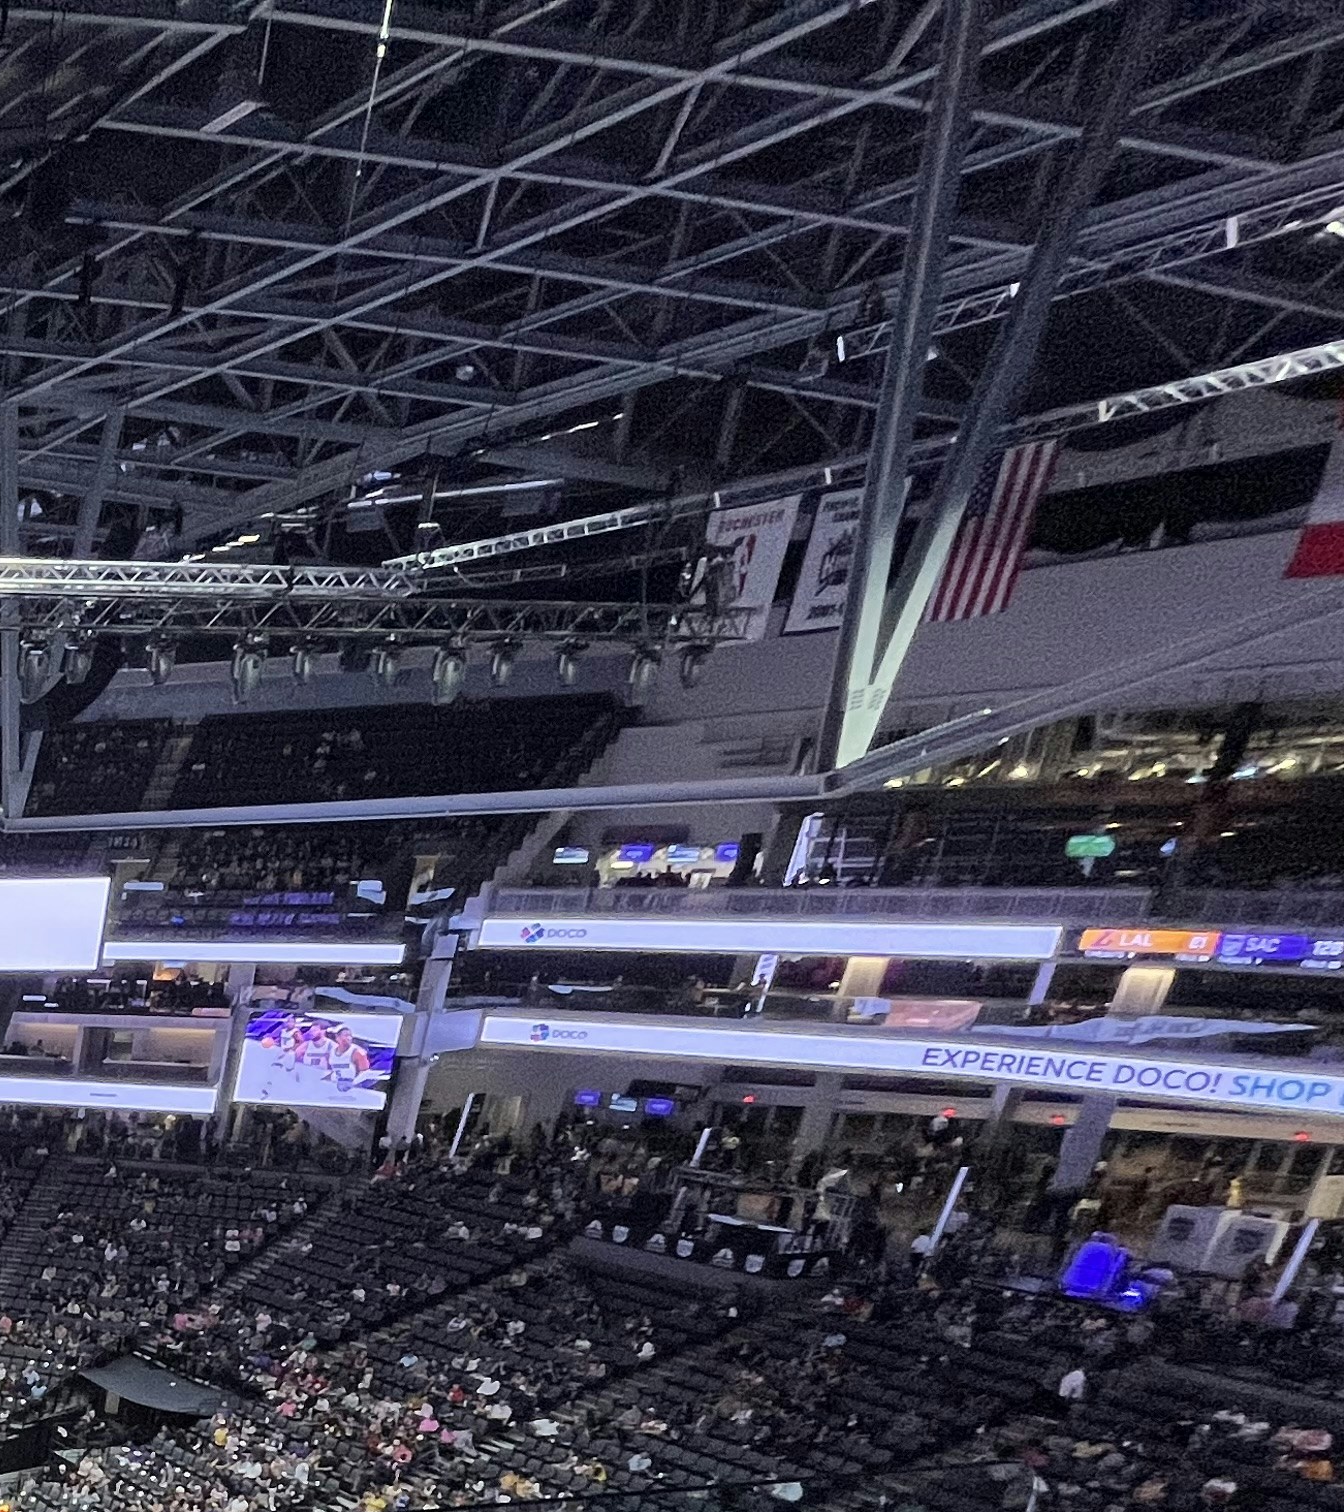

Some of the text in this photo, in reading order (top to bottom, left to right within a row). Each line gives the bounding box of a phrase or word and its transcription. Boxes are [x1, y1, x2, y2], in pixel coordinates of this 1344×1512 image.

[547, 928, 588, 939] DOCO
[1119, 933, 1153, 947] LAL
[1245, 937, 1281, 953] SAC
[552, 1029, 588, 1040] DOCO
[921, 1047, 1333, 1103] EXPERIENCE DOCO! SHOP
